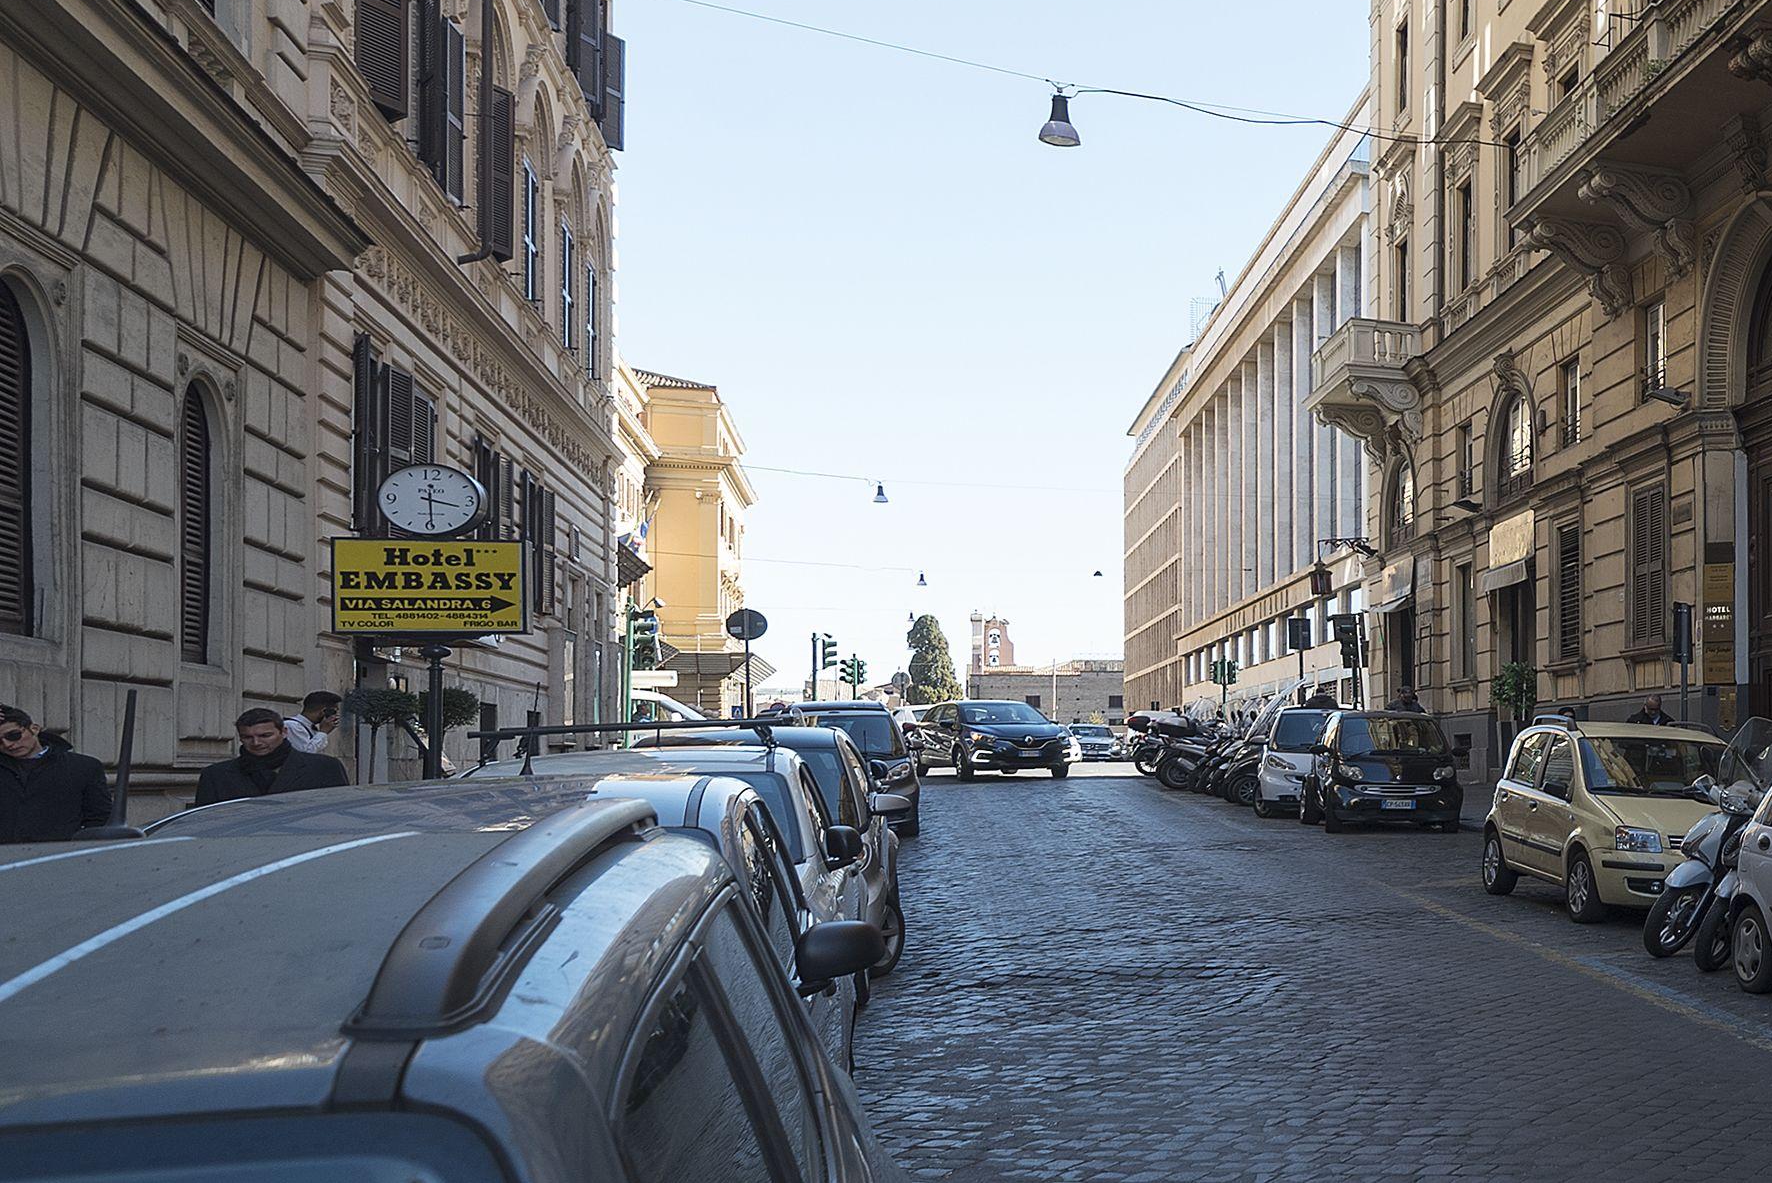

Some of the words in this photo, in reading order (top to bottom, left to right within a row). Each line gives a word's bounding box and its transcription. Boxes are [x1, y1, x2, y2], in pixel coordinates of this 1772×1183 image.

[422, 469, 441, 481] 12
[386, 492, 397, 504] 9
[465, 495, 475, 507] 3
[383, 548, 476, 566] Hotel
[340, 571, 517, 590] EMBASSY
[344, 599, 377, 609] VIA
[1705, 606, 1731, 614] HOTEL
[340, 620, 356, 628] TV
[357, 620, 395, 628] COLOR
[463, 620, 494, 628] FRIGO
[497, 620, 518, 628] BAR
